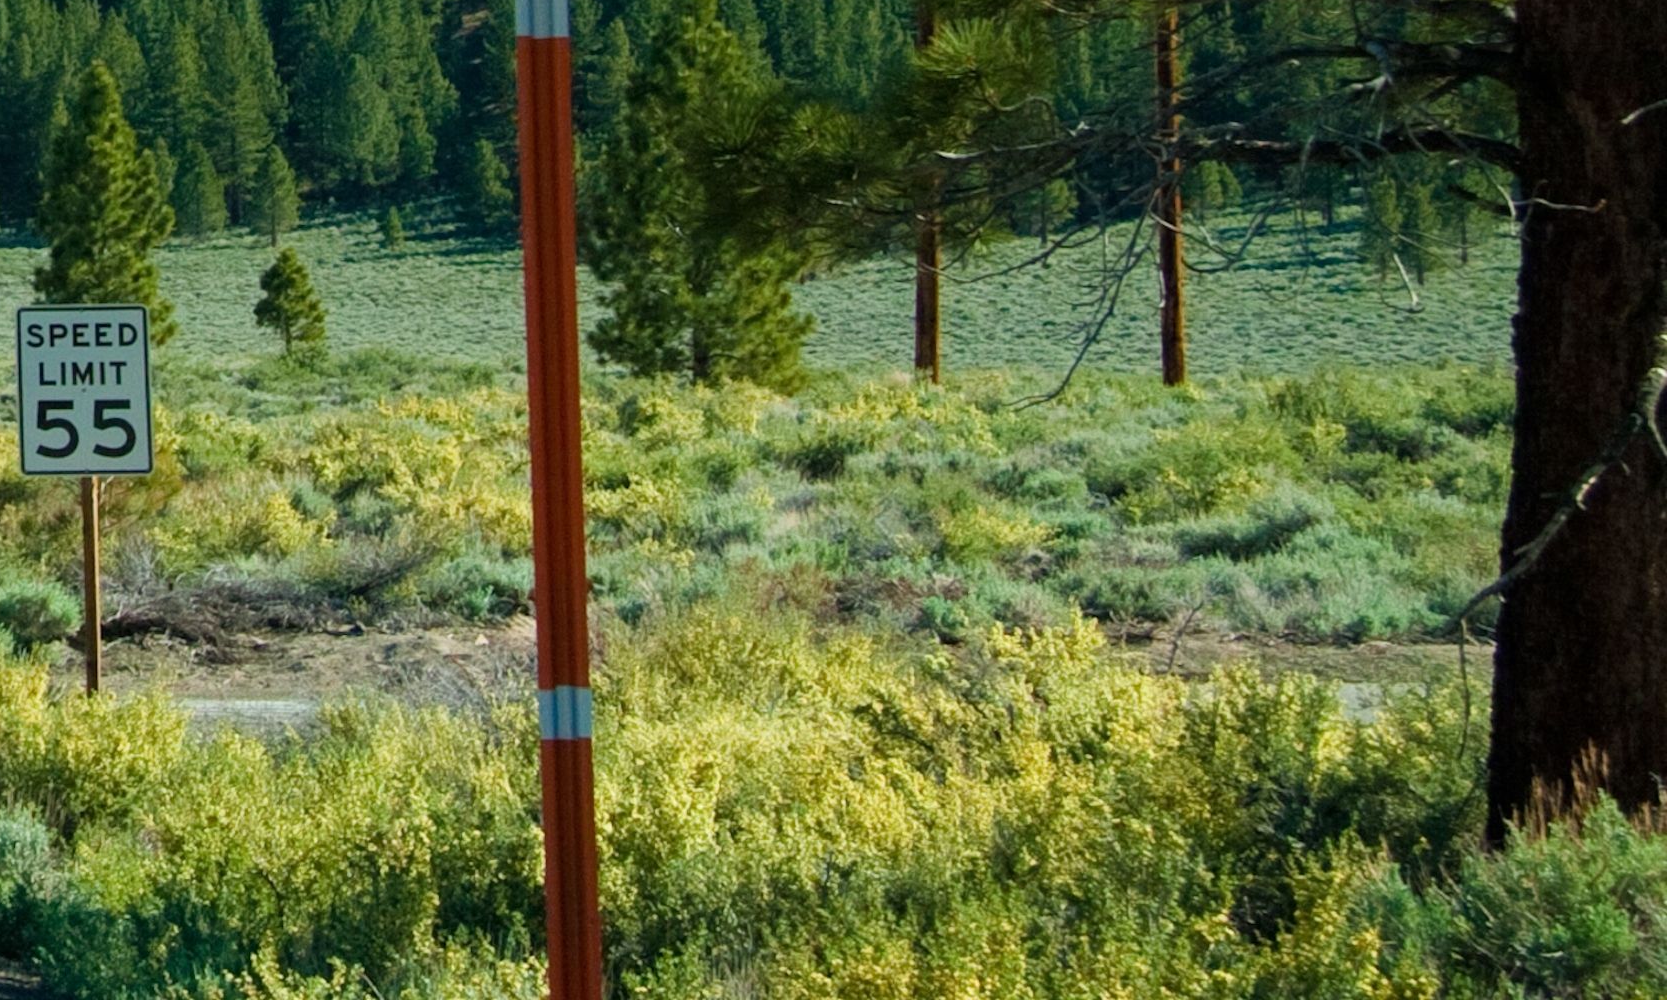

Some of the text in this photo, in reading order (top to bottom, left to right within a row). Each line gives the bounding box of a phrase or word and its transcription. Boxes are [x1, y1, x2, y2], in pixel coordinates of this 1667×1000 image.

[27, 322, 138, 348] SPEED
[38, 361, 127, 386] LIMIT
[36, 399, 136, 459] 55
